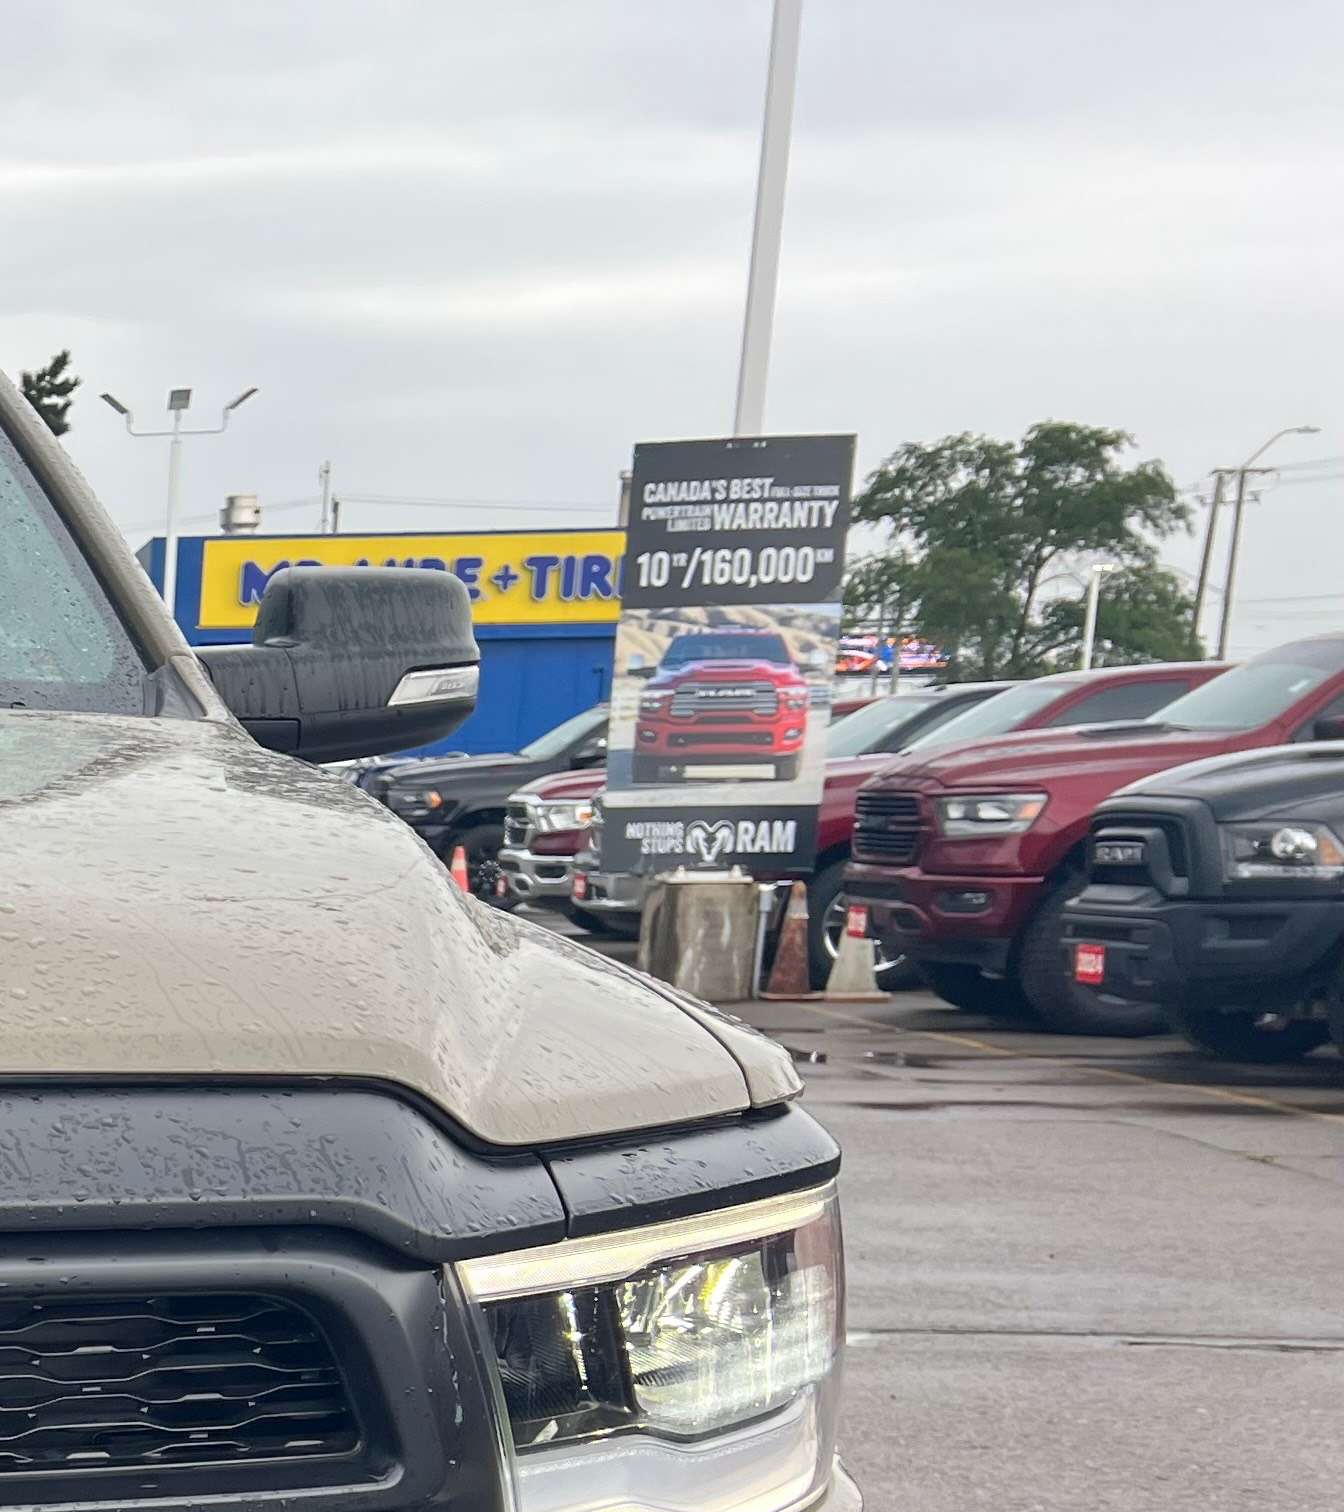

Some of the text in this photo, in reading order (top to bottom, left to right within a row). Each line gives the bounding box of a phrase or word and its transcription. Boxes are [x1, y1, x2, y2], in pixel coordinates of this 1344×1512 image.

[643, 479, 727, 503] CANADA'S
[729, 477, 775, 499] BEST
[713, 500, 840, 531] WARRANTY
[523, 554, 625, 600] TIR
[736, 820, 798, 853] RAM
